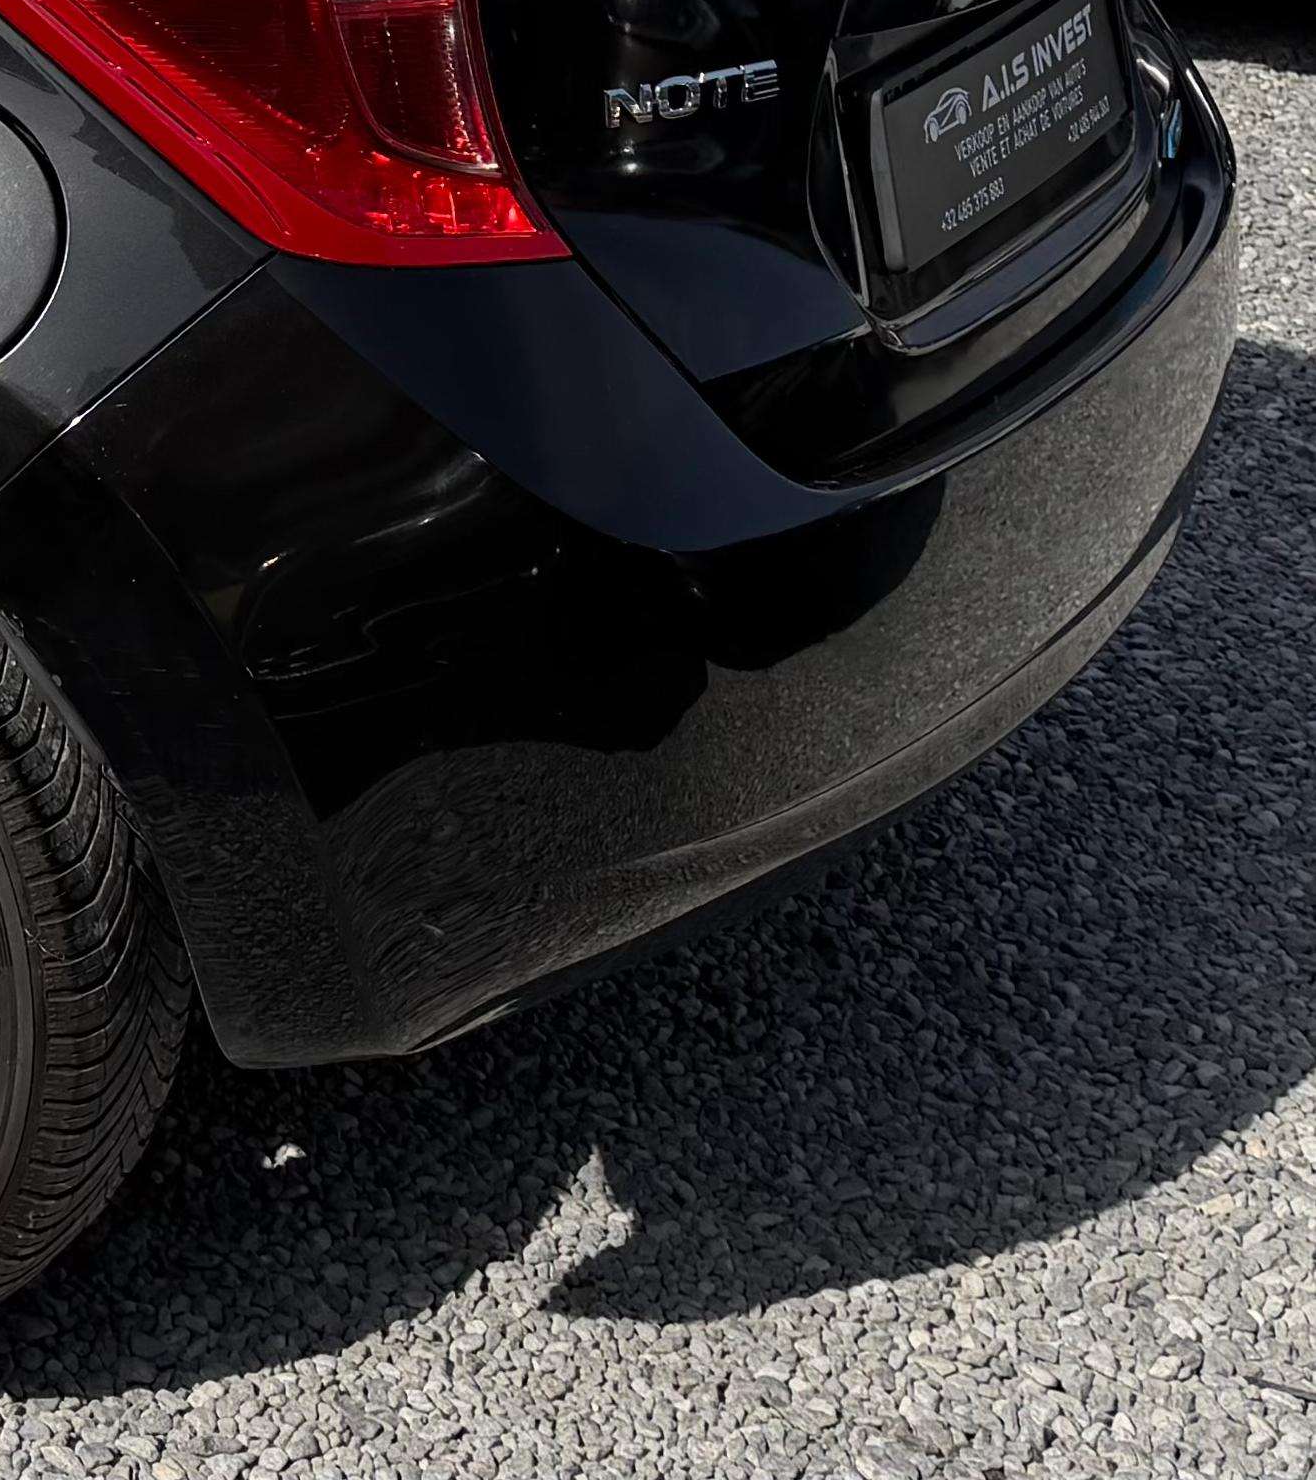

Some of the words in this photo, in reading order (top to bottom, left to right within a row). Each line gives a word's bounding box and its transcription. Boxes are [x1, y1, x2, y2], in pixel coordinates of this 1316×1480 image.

[1031, 3, 1092, 77] INVEST
[604, 59, 780, 128] NOTE
[954, 123, 995, 162] VERKOOP
[997, 113, 1010, 136] EN
[969, 146, 999, 178] VENTE
[1000, 136, 1012, 159] ET
